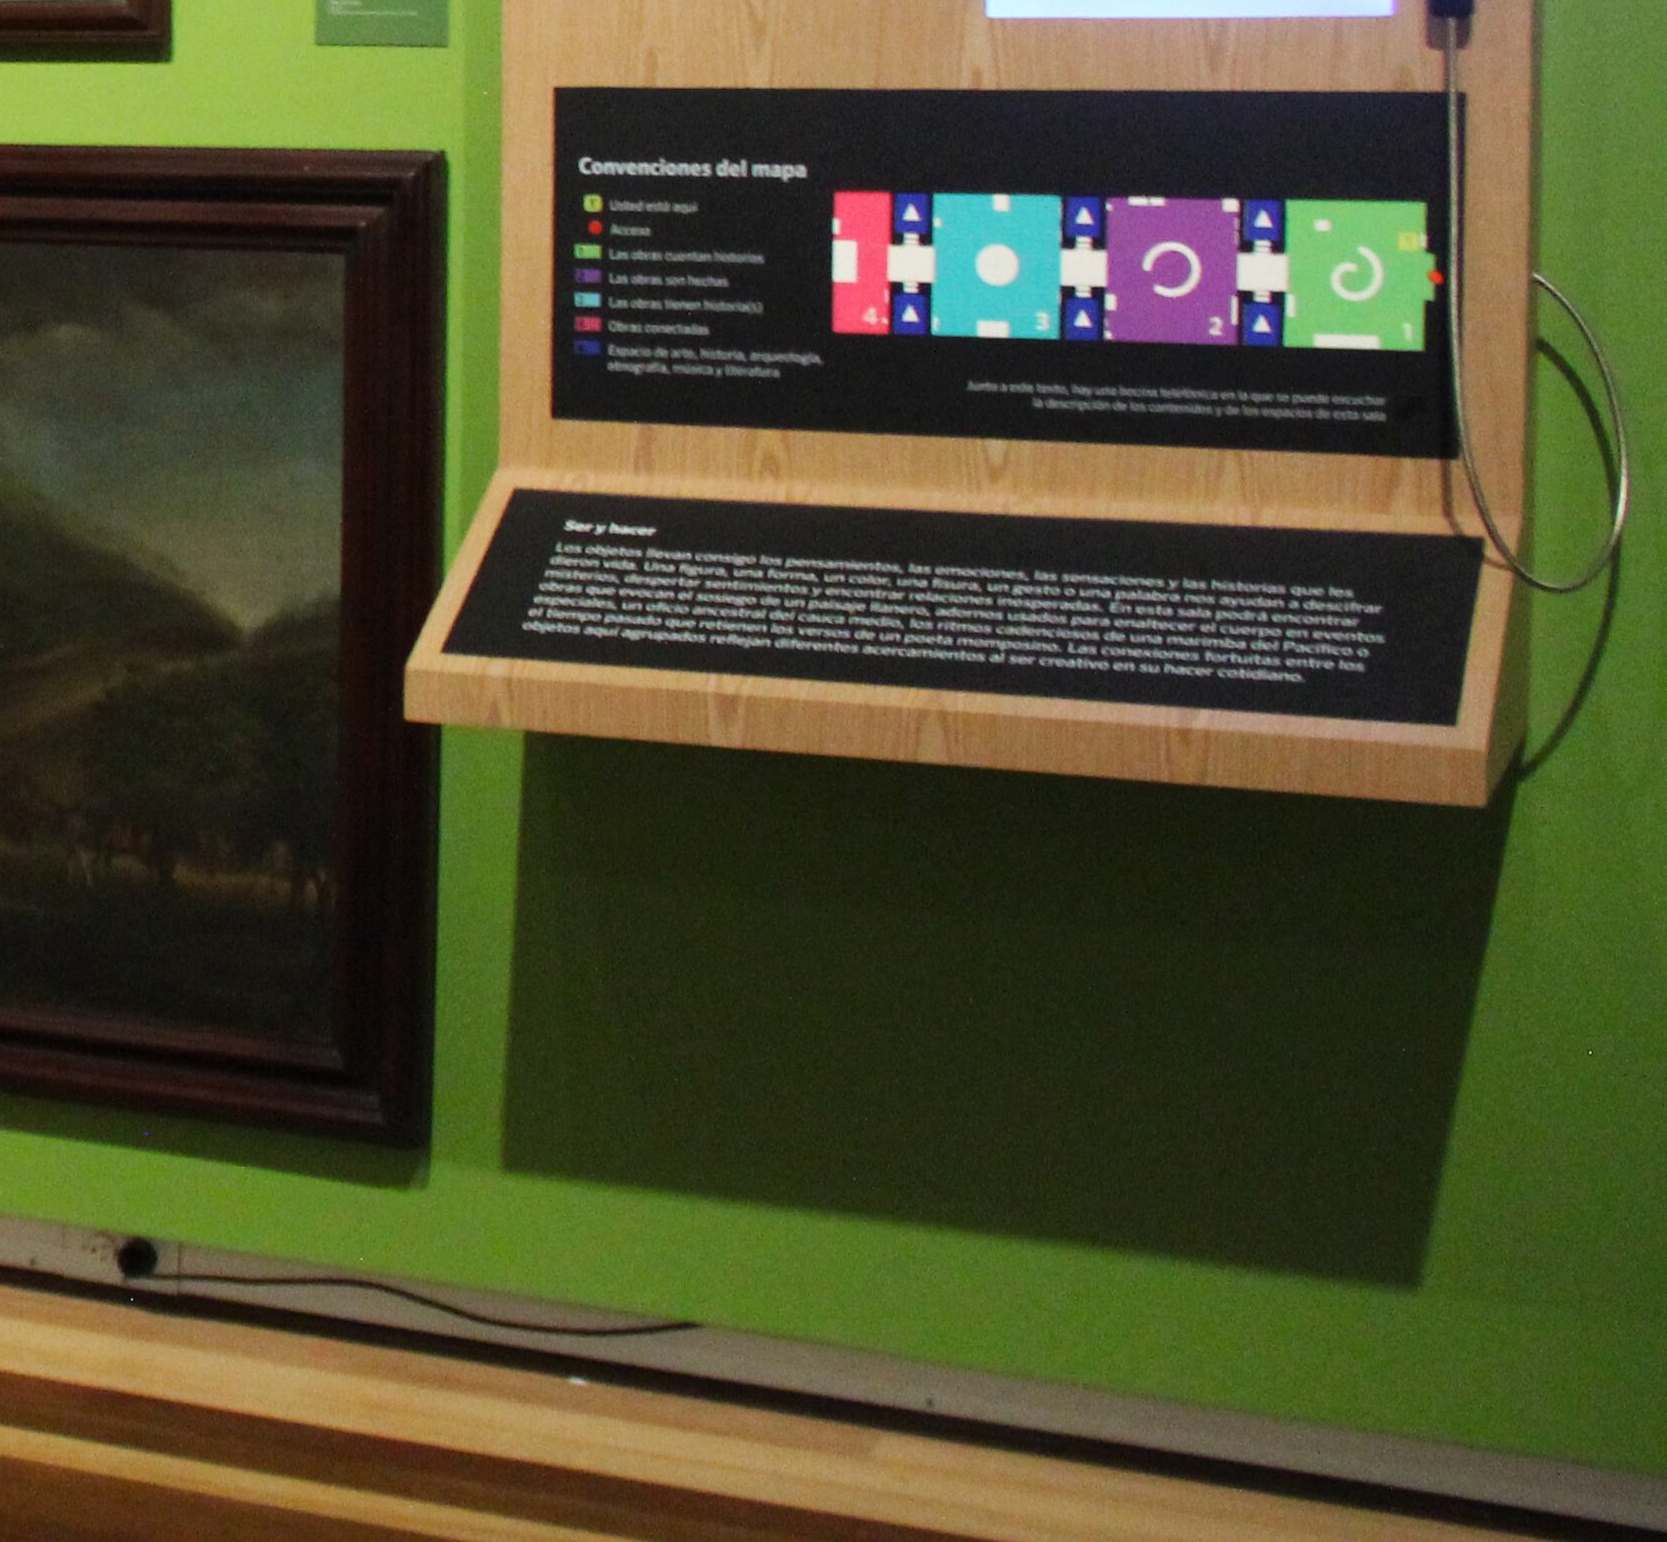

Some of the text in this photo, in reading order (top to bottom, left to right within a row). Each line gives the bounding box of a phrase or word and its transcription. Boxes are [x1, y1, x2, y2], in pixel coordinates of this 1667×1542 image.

[578, 158, 807, 182] Convenciones del mapa
[862, 307, 879, 325] 4
[1035, 310, 1051, 332] 3
[1208, 316, 1224, 337] 2
[564, 519, 656, 536] Ser y hacer
